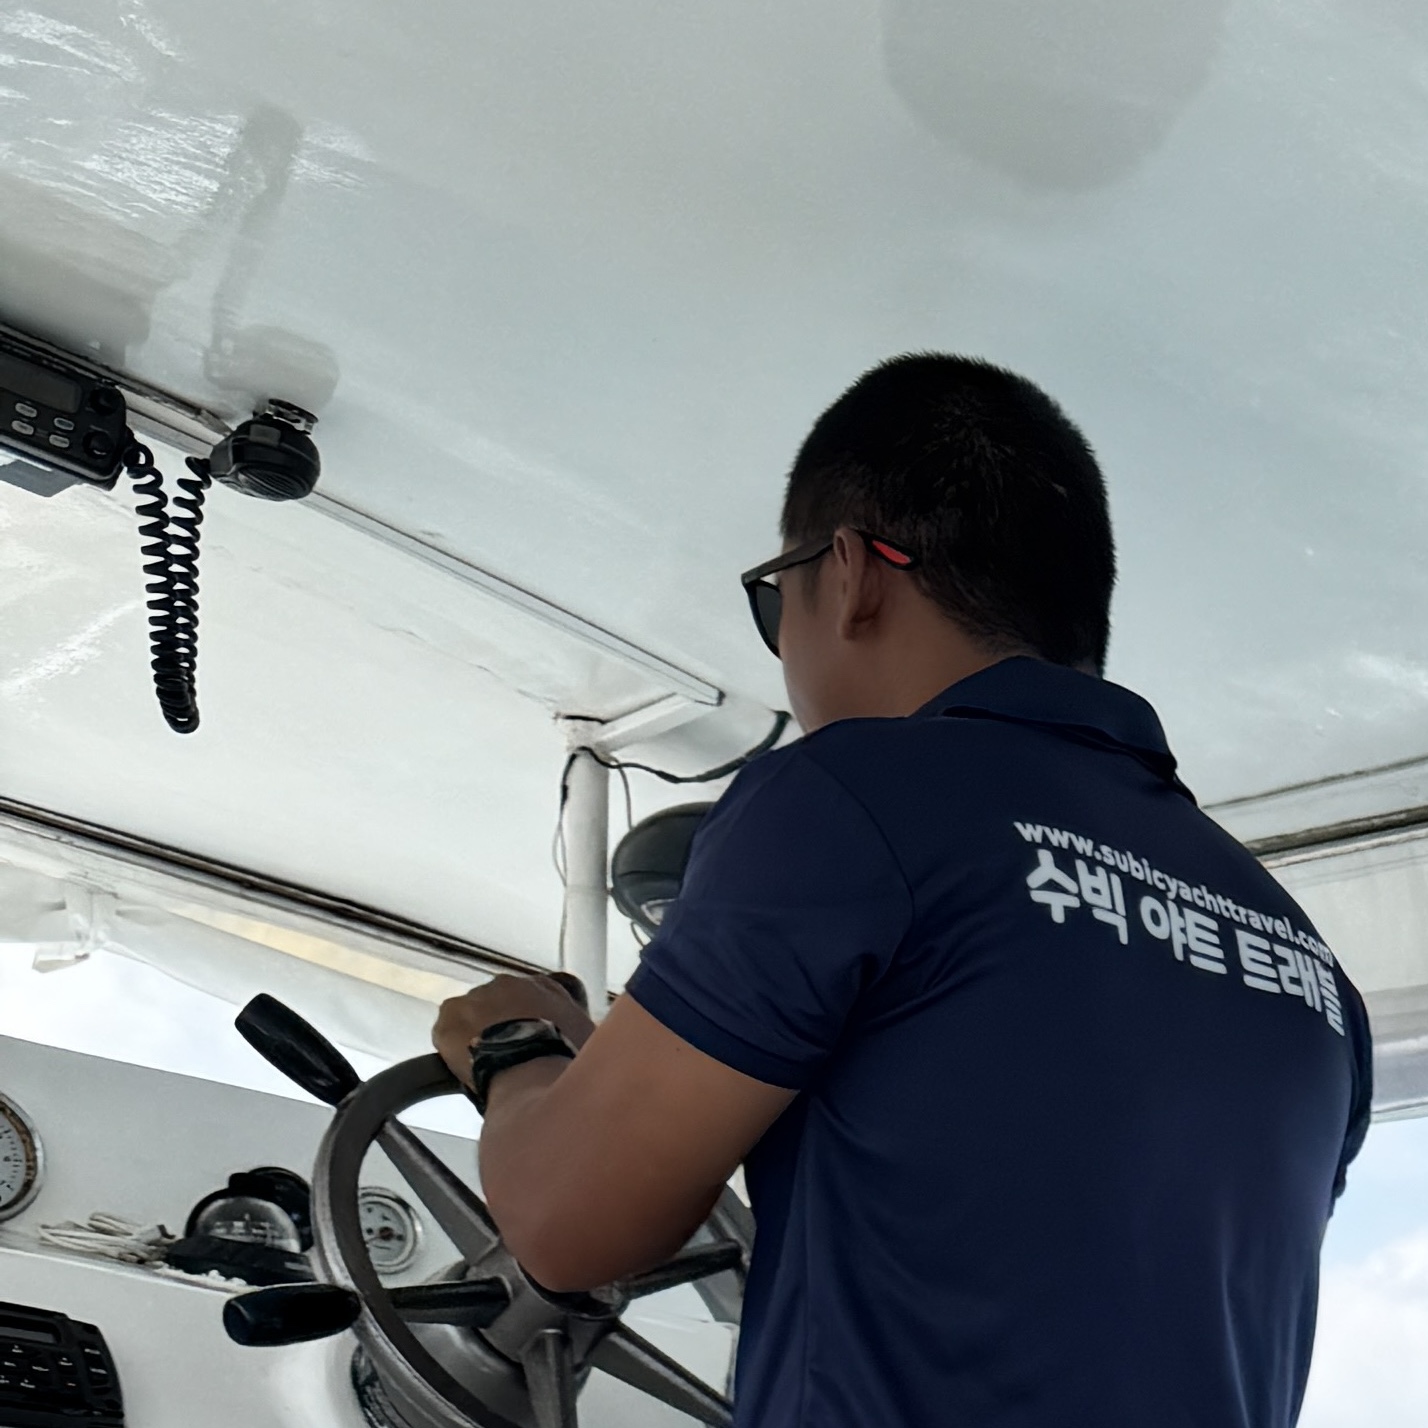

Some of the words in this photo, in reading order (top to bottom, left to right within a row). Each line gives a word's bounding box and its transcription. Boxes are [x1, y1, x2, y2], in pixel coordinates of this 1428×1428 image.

[1013, 821, 1334, 968] www.subicyachttravel.com
[1026, 849, 1129, 945] 수빅
[1139, 895, 1228, 974] 야트
[1235, 928, 1346, 1037] 트래블
